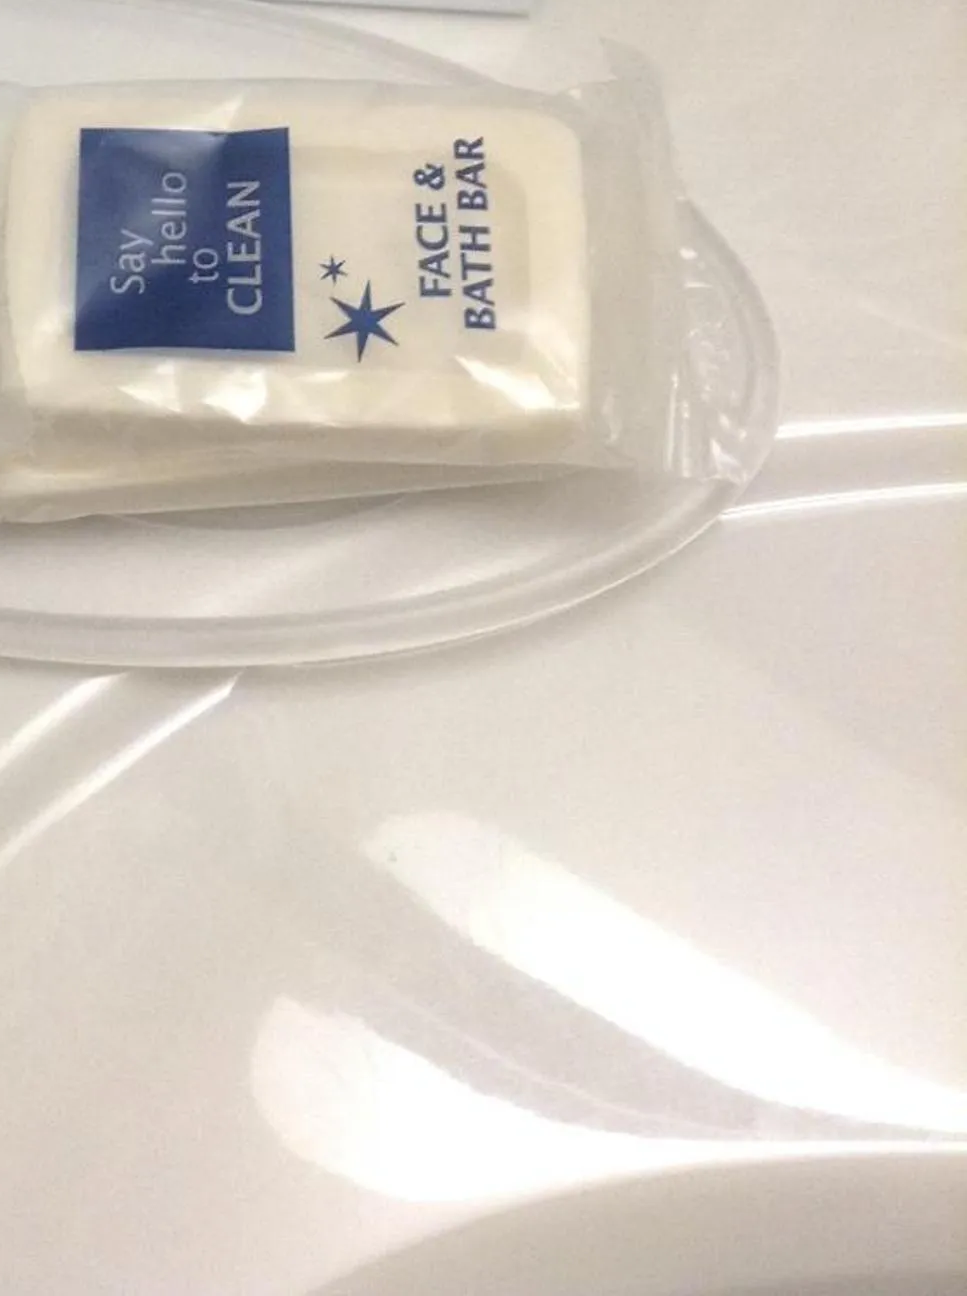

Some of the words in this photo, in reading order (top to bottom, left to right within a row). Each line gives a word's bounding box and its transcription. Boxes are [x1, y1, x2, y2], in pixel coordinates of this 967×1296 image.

[412, 163, 446, 191] &
[452, 136, 489, 211] BAR
[151, 171, 187, 265] hello
[226, 180, 263, 316] CLEAN
[415, 202, 452, 298] FACE
[109, 228, 154, 295] Say
[188, 247, 220, 284] to
[459, 224, 497, 330] BATH
